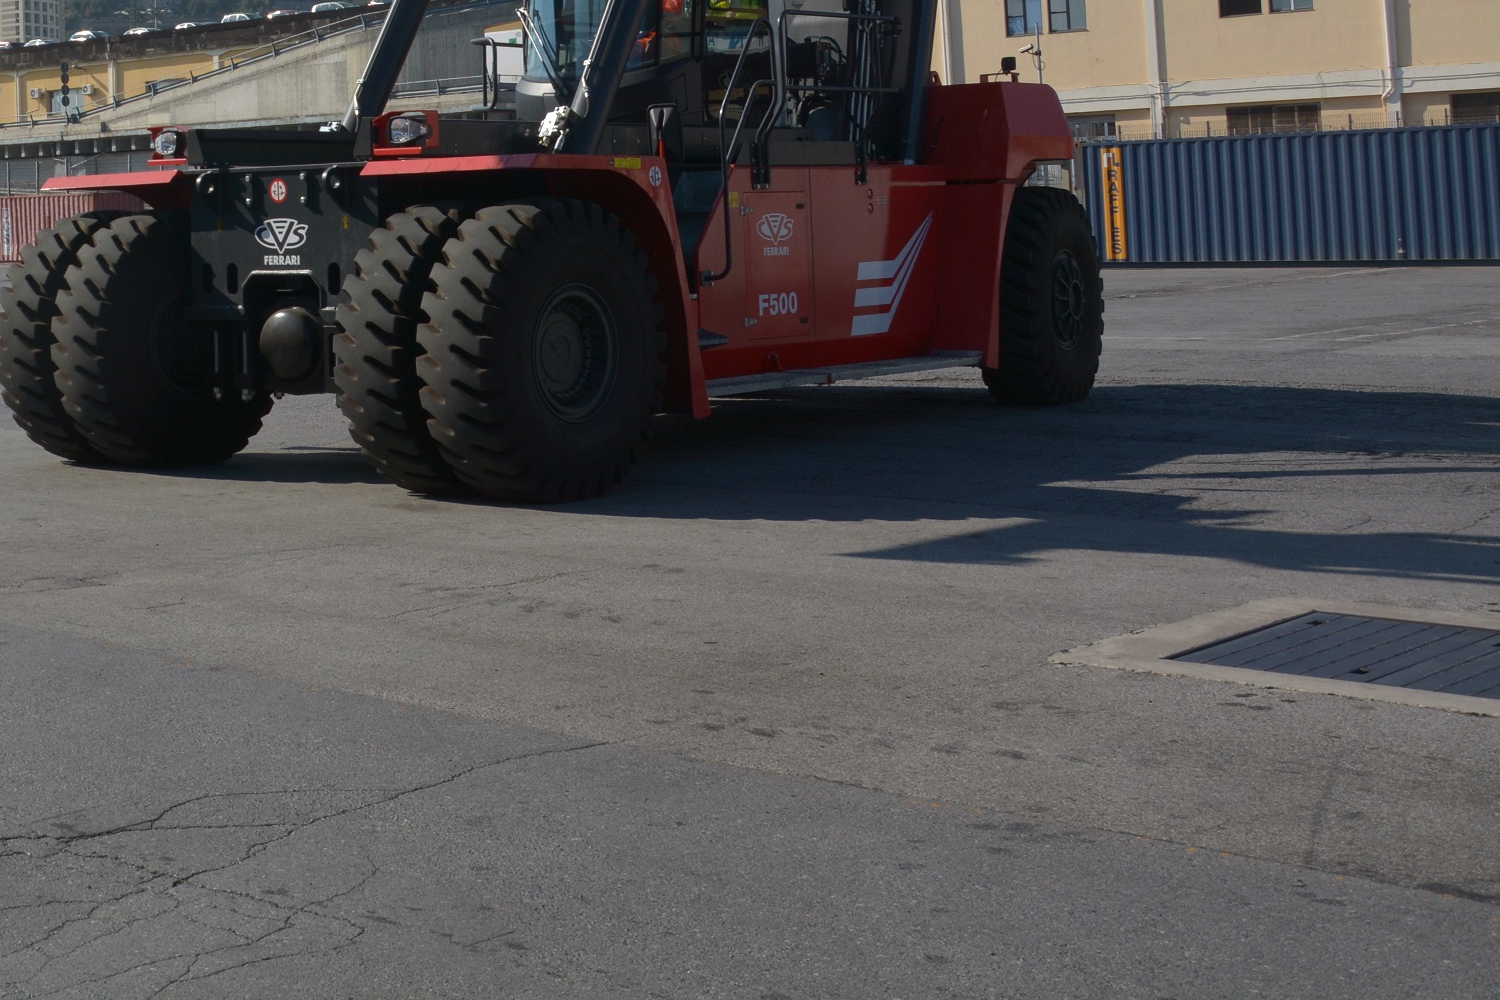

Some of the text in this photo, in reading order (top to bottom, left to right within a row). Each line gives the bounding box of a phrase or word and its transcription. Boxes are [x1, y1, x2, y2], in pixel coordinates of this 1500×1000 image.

[1108, 169, 1122, 255] RAFFLES
[255, 218, 308, 254] CVS
[756, 213, 794, 245] CVS
[263, 255, 300, 265] FERRARI
[763, 246, 790, 256] FERRARI
[758, 292, 798, 316] F500
